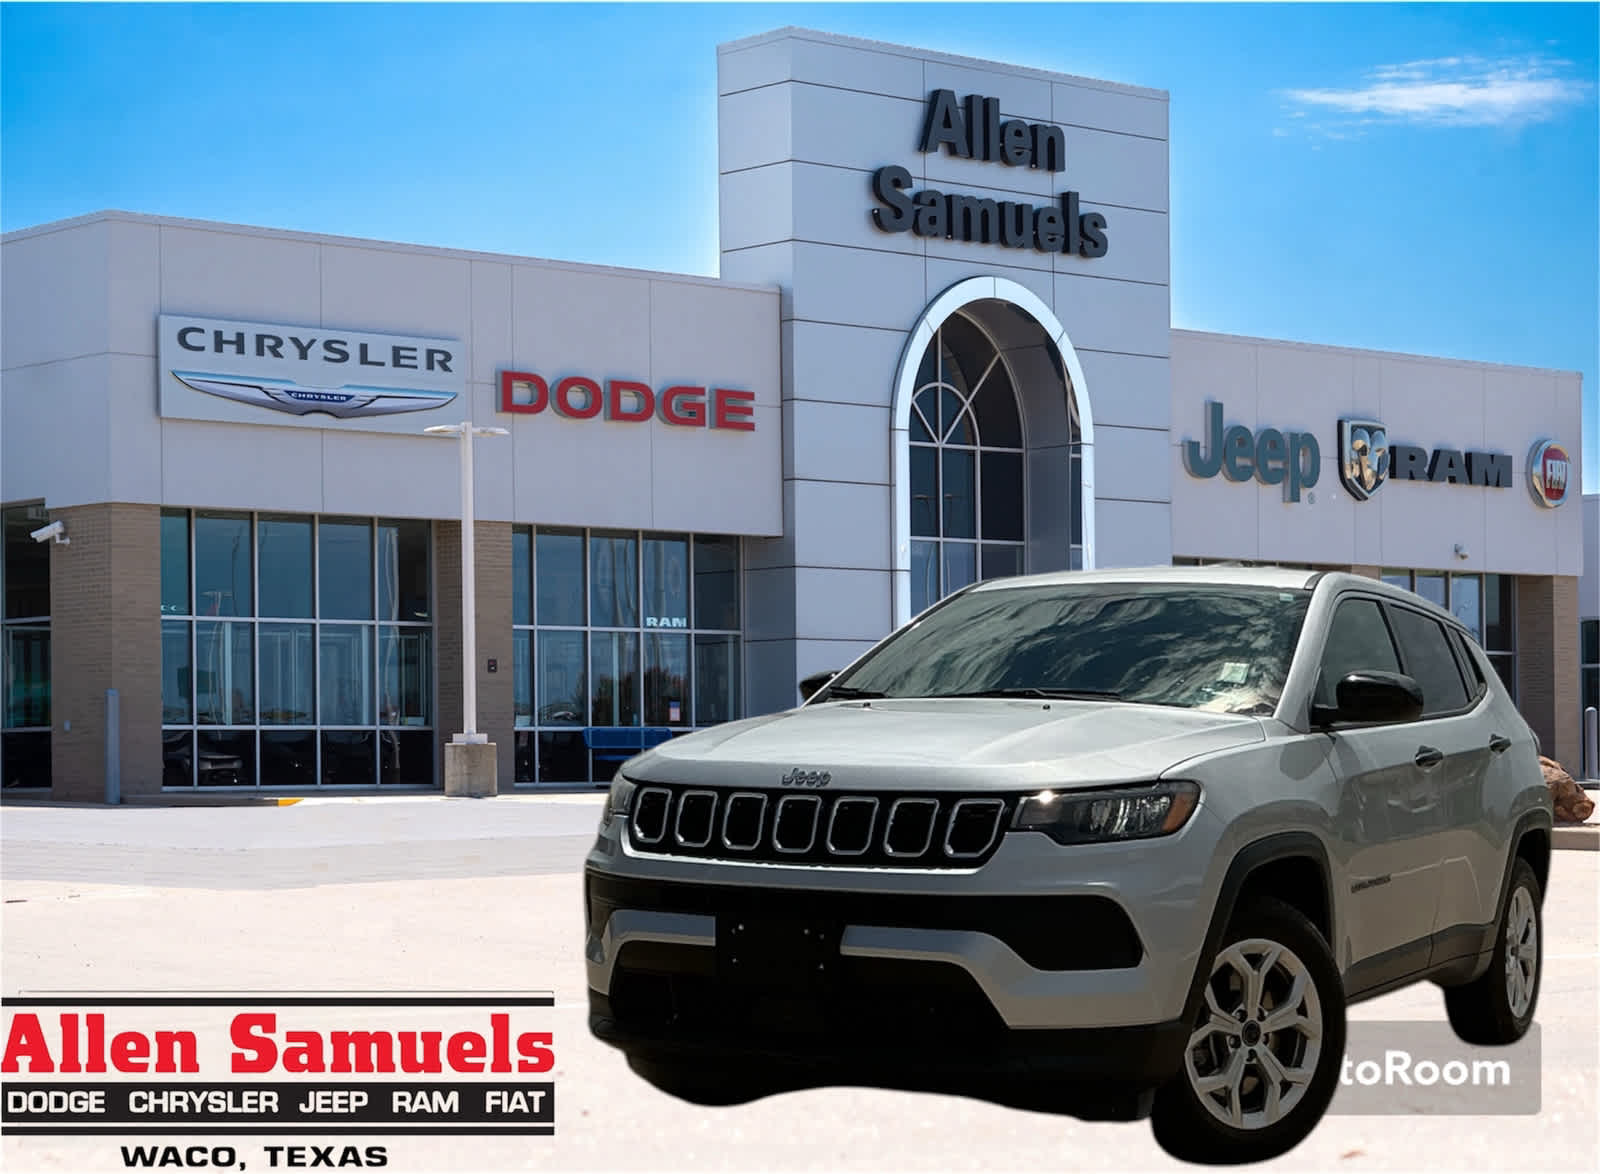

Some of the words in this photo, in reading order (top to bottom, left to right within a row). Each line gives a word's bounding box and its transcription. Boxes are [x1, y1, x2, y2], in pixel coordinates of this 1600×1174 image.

[920, 88, 1066, 172] Allen
[872, 165, 1108, 258] Samuels
[176, 326, 455, 373] CHRYSLER
[290, 392, 347, 401] CHRYSLER
[497, 369, 756, 431] DODGE
[1183, 401, 1320, 503] Jeep
[1389, 445, 1513, 488] RAM
[646, 616, 687, 628] RAM
[781, 767, 832, 788] Jeep
